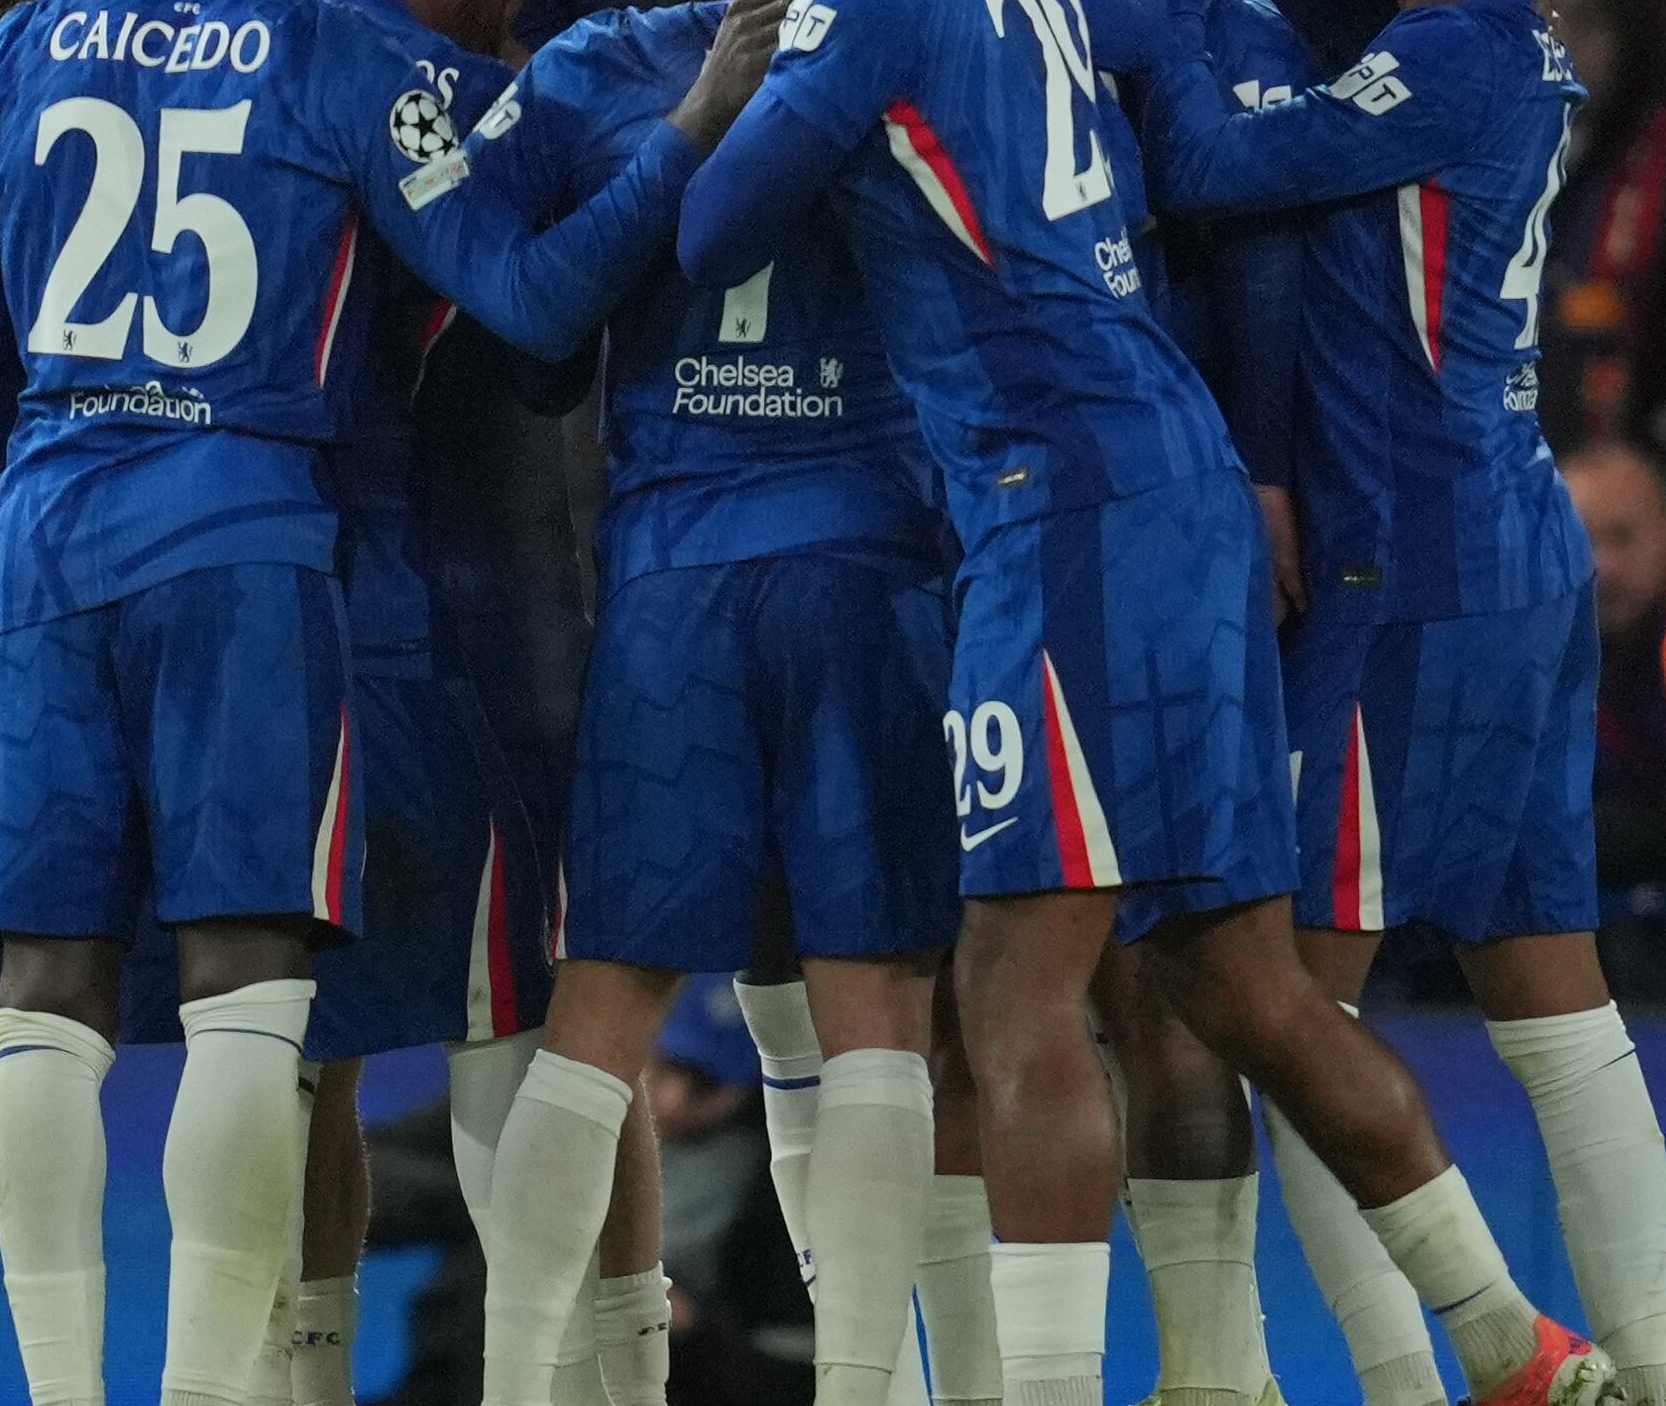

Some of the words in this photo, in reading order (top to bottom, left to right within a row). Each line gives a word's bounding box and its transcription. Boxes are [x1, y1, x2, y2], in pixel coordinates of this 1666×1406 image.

[49, 10, 270, 73] CAICEDO
[28, 96, 258, 369] 25
[672, 386, 844, 417] Foundation
[674, 355, 794, 387] Chelsea
[942, 700, 1024, 817] 29
